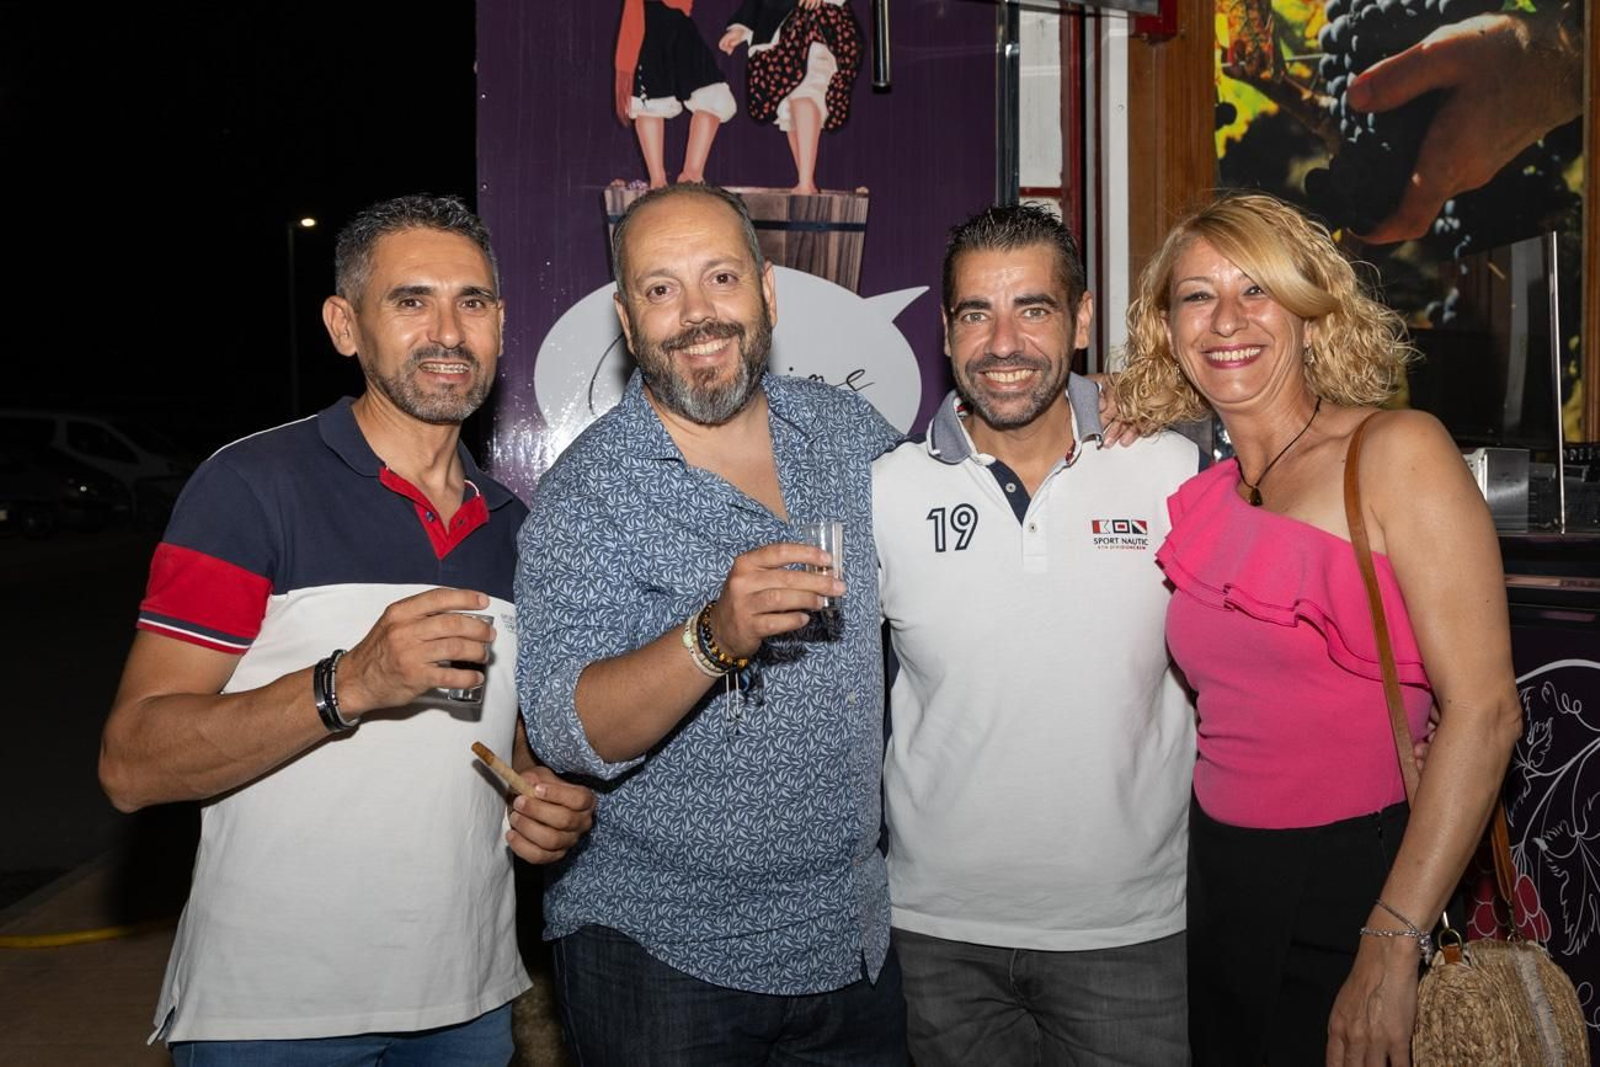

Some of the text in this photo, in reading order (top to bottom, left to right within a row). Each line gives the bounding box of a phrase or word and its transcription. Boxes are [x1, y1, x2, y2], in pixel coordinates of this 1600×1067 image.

[926, 503, 978, 552] 19
[1093, 537, 1149, 546] SPORT NAUTIC
